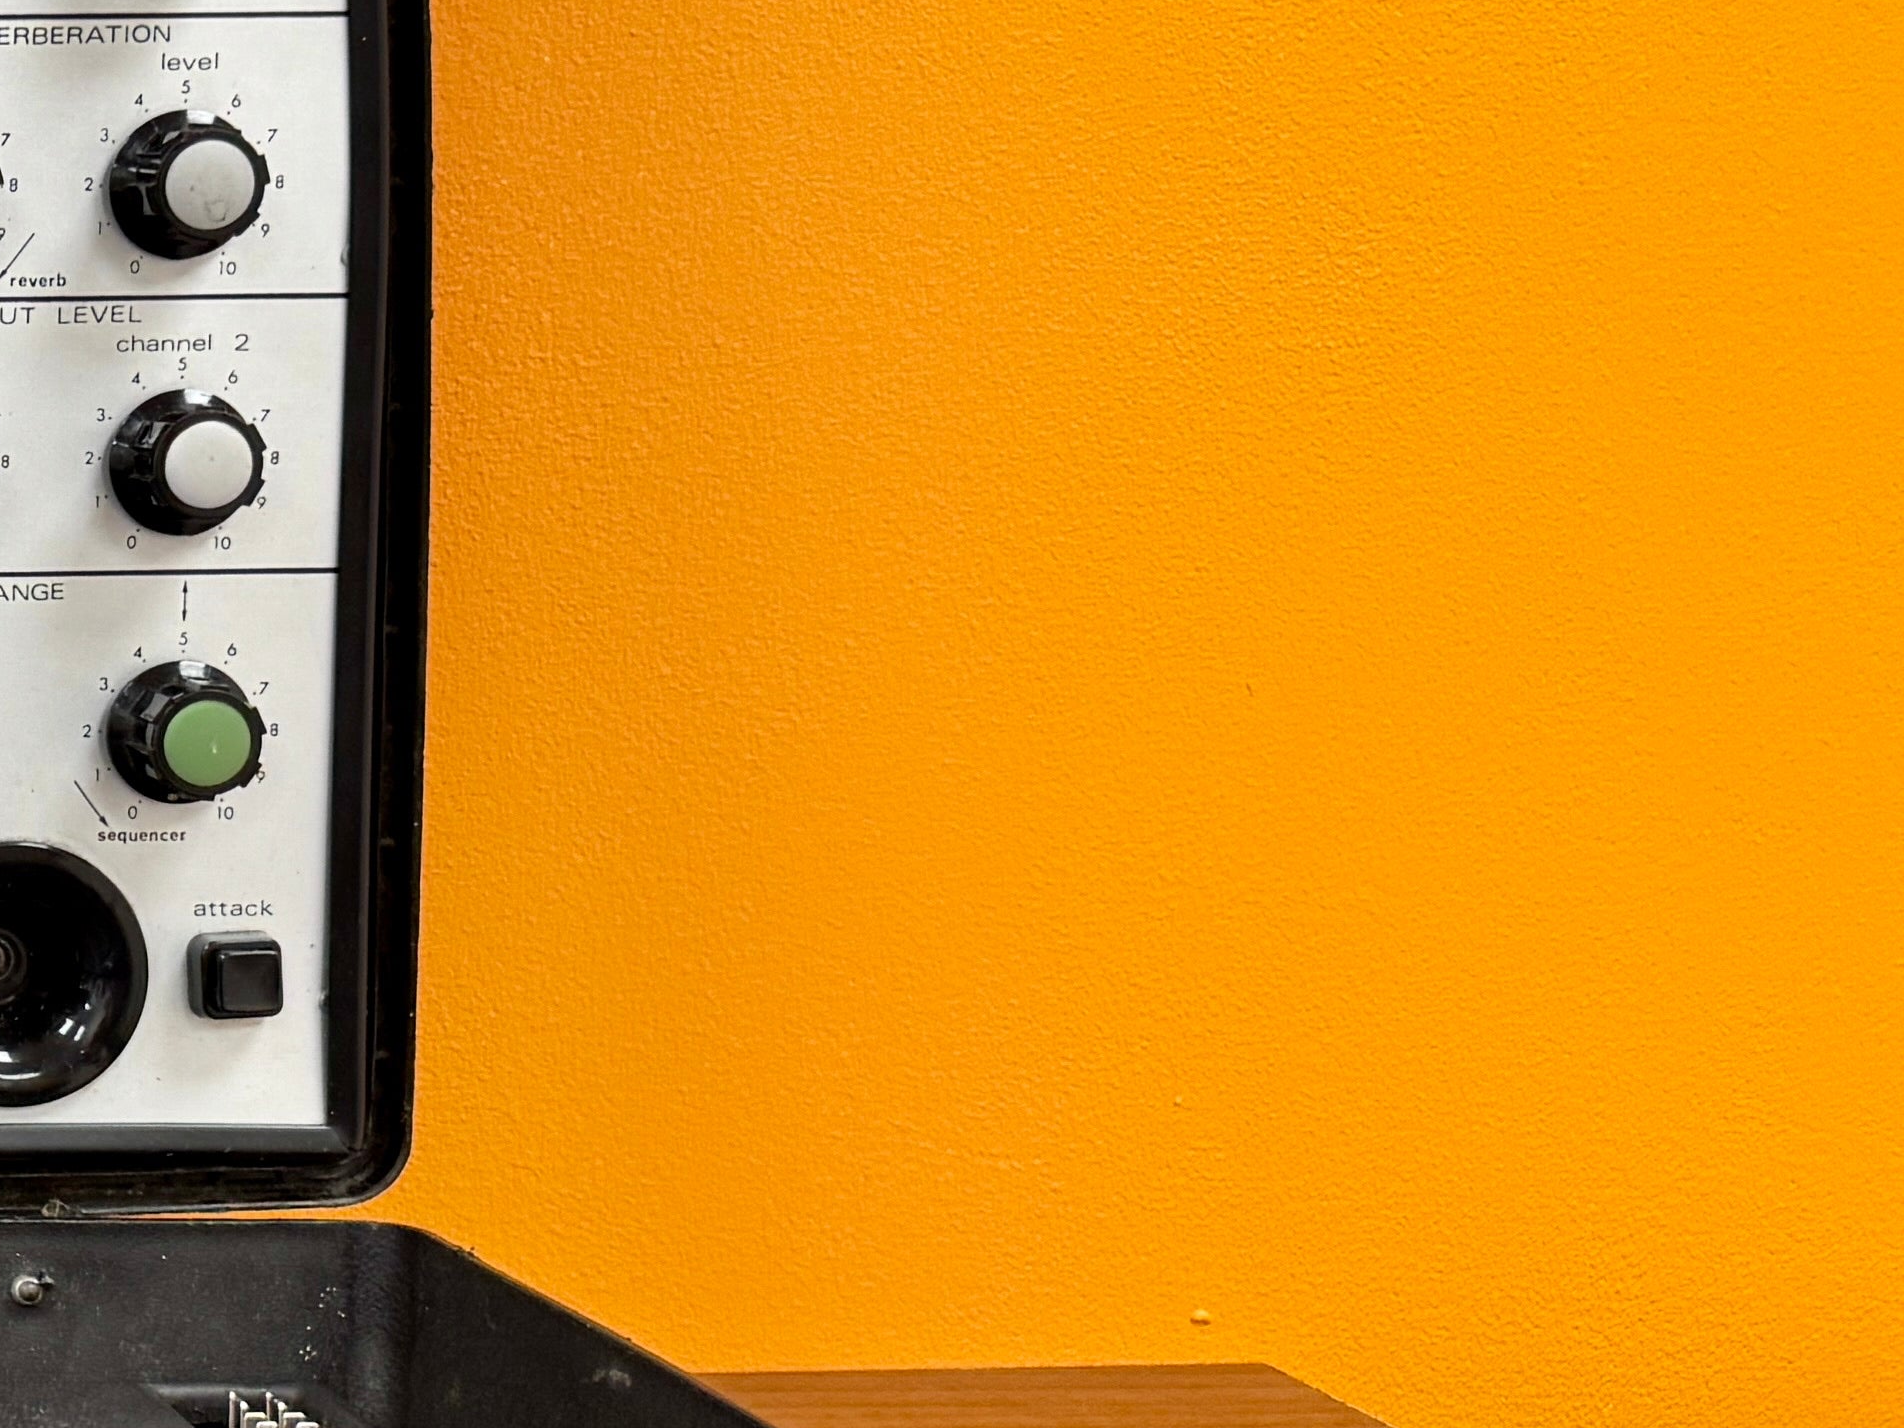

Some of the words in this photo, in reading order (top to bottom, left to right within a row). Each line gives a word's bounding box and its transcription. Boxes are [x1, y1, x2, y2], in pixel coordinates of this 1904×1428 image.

[162, 53, 218, 70] level
[11, 274, 66, 287] reverb
[58, 305, 141, 324] LEVEL
[117, 335, 211, 352] channel
[98, 832, 185, 843] sequencer
[194, 900, 272, 916] attack
